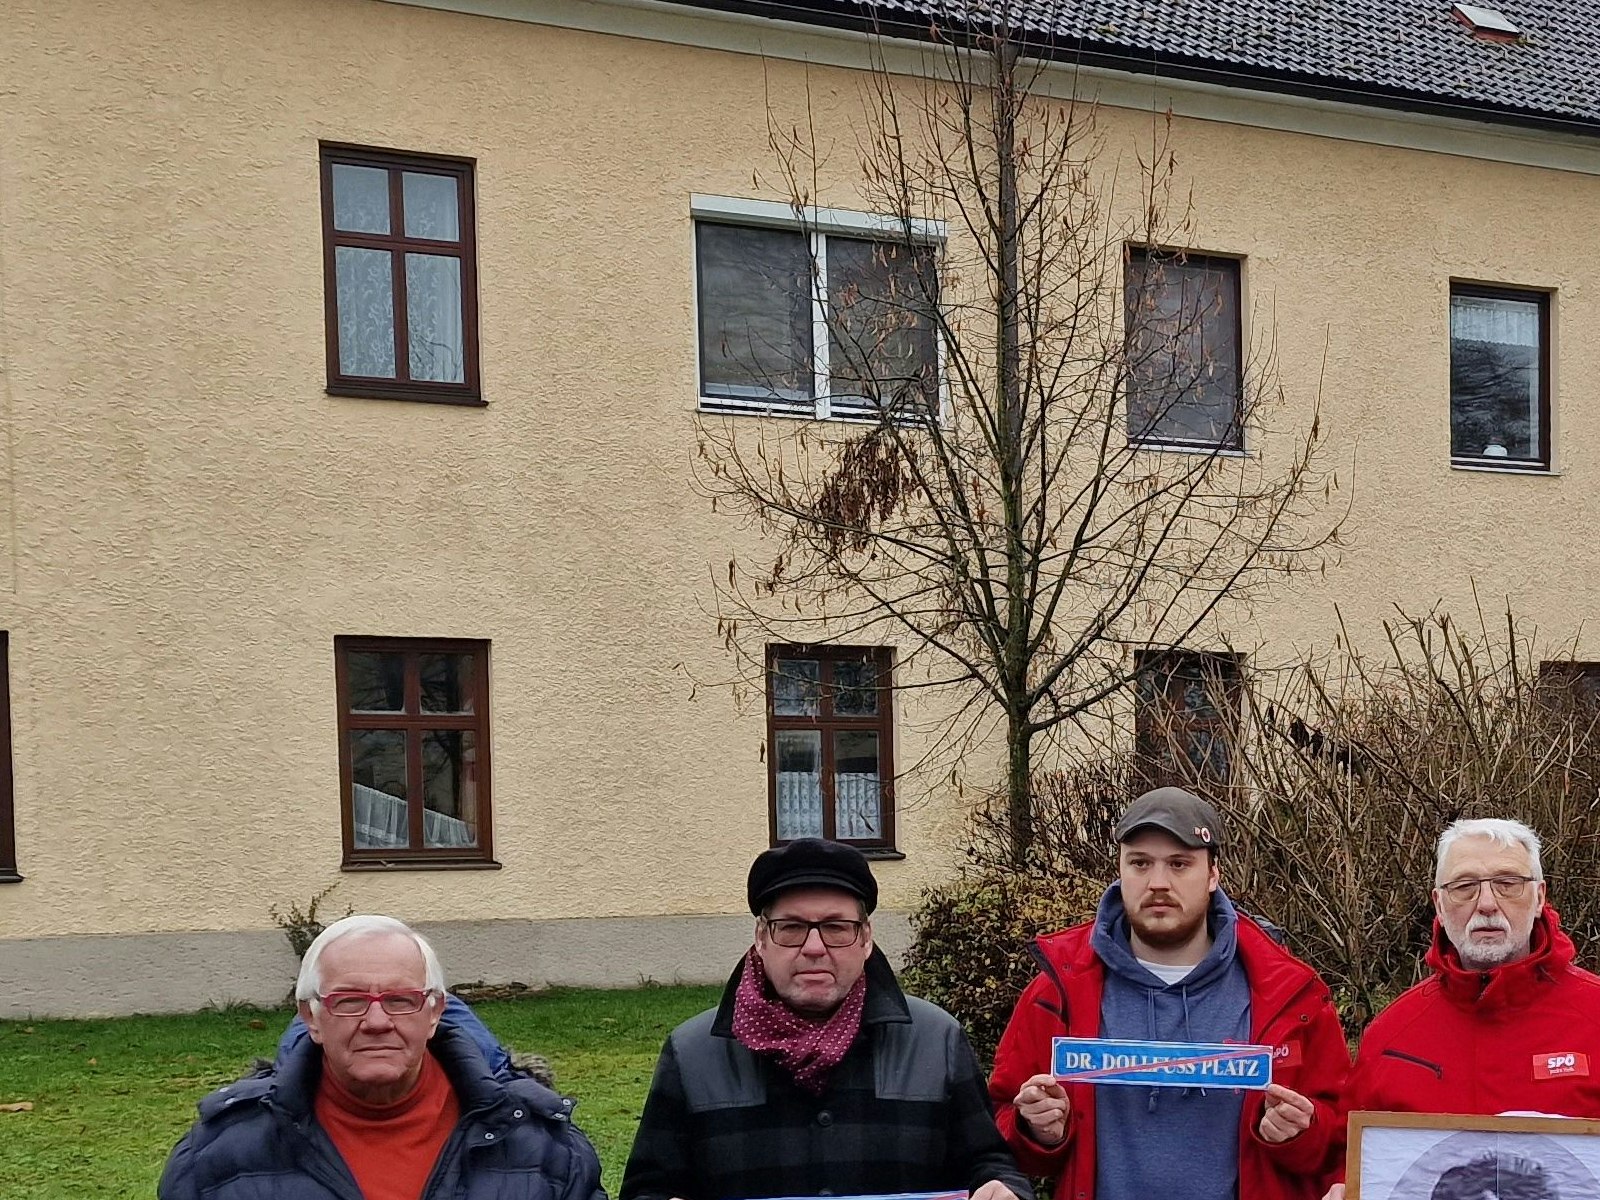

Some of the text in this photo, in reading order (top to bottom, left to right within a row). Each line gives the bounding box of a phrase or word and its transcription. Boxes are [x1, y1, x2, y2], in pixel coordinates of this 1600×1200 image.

[1066, 1052, 1259, 1077] DR. DOLLFUSS PLATZ
[1548, 1054, 1575, 1068] SPÖ
